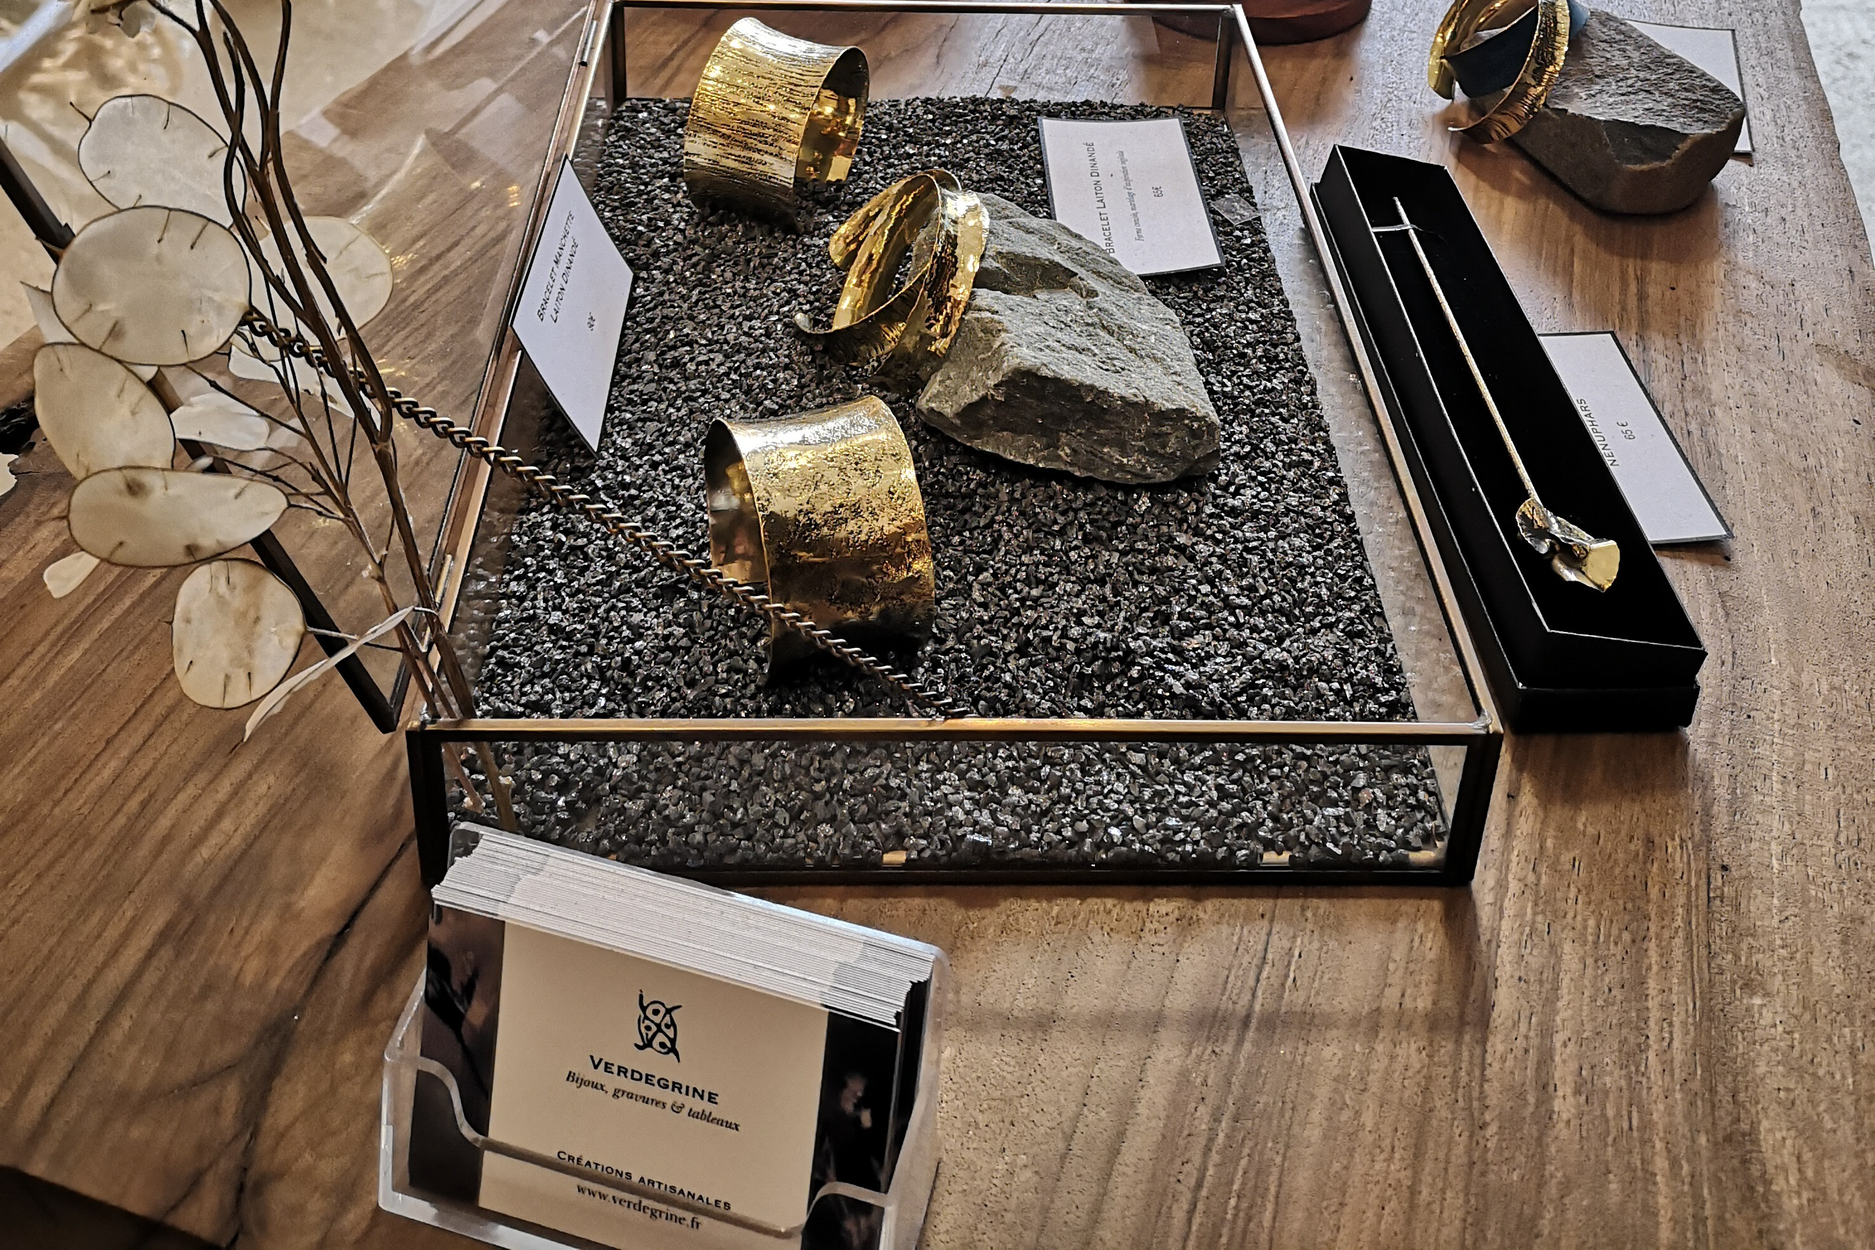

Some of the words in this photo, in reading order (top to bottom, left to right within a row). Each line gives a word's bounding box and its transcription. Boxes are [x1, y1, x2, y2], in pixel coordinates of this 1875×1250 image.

[1083, 141, 1100, 178] DINANDÉ
[1093, 179, 1107, 210] LAITON
[1099, 211, 1116, 254] BRACELET
[536, 266, 558, 323] BRACELET
[552, 210, 575, 269] MANCHETTE
[550, 283, 566, 324] LAITON
[561, 235, 579, 285] DINANDÉ
[1576, 398, 1620, 467] NENUPHARS
[565, 1069, 609, 1095] Bijoux,
[611, 1086, 668, 1111] gravures
[670, 1100, 686, 1115] &
[686, 1106, 741, 1133] tableaux
[588, 1053, 720, 1106] VERDEGRINE
[556, 1150, 634, 1181] CRÉATIONS
[637, 1175, 733, 1212] ARTISANALES
[575, 1183, 702, 1231] www.verdegrine.fr
